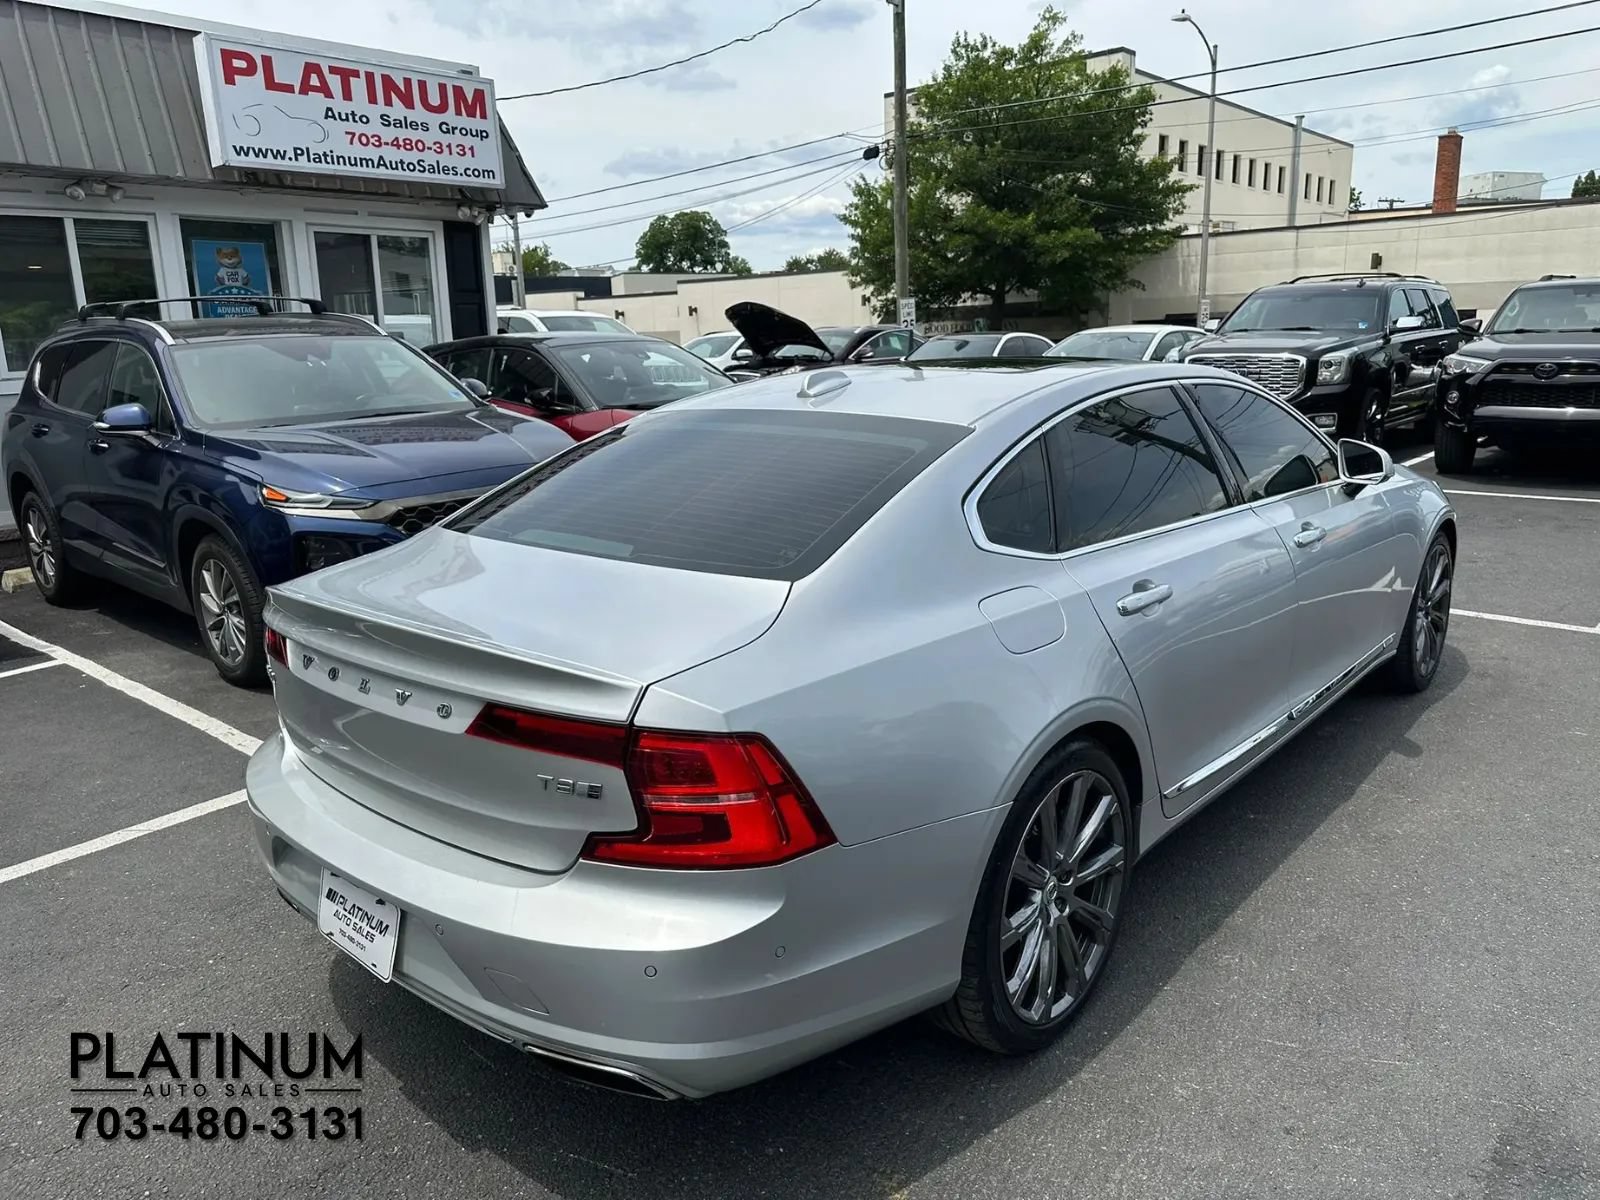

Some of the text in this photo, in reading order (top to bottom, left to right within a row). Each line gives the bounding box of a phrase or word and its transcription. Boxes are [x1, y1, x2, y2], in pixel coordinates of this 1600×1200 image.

[219, 48, 489, 120] PLATINUM
[323, 106, 490, 141] Auto Sales Group
[232, 144, 496, 180] www.PlatinumAutoSales.com
[344, 131, 476, 158] 703-480-3131
[218, 306, 257, 314] ADVANTAGE
[302, 653, 453, 720] VOLVO
[333, 909, 376, 944] AUTO SALES
[336, 894, 390, 937] PLATINUM
